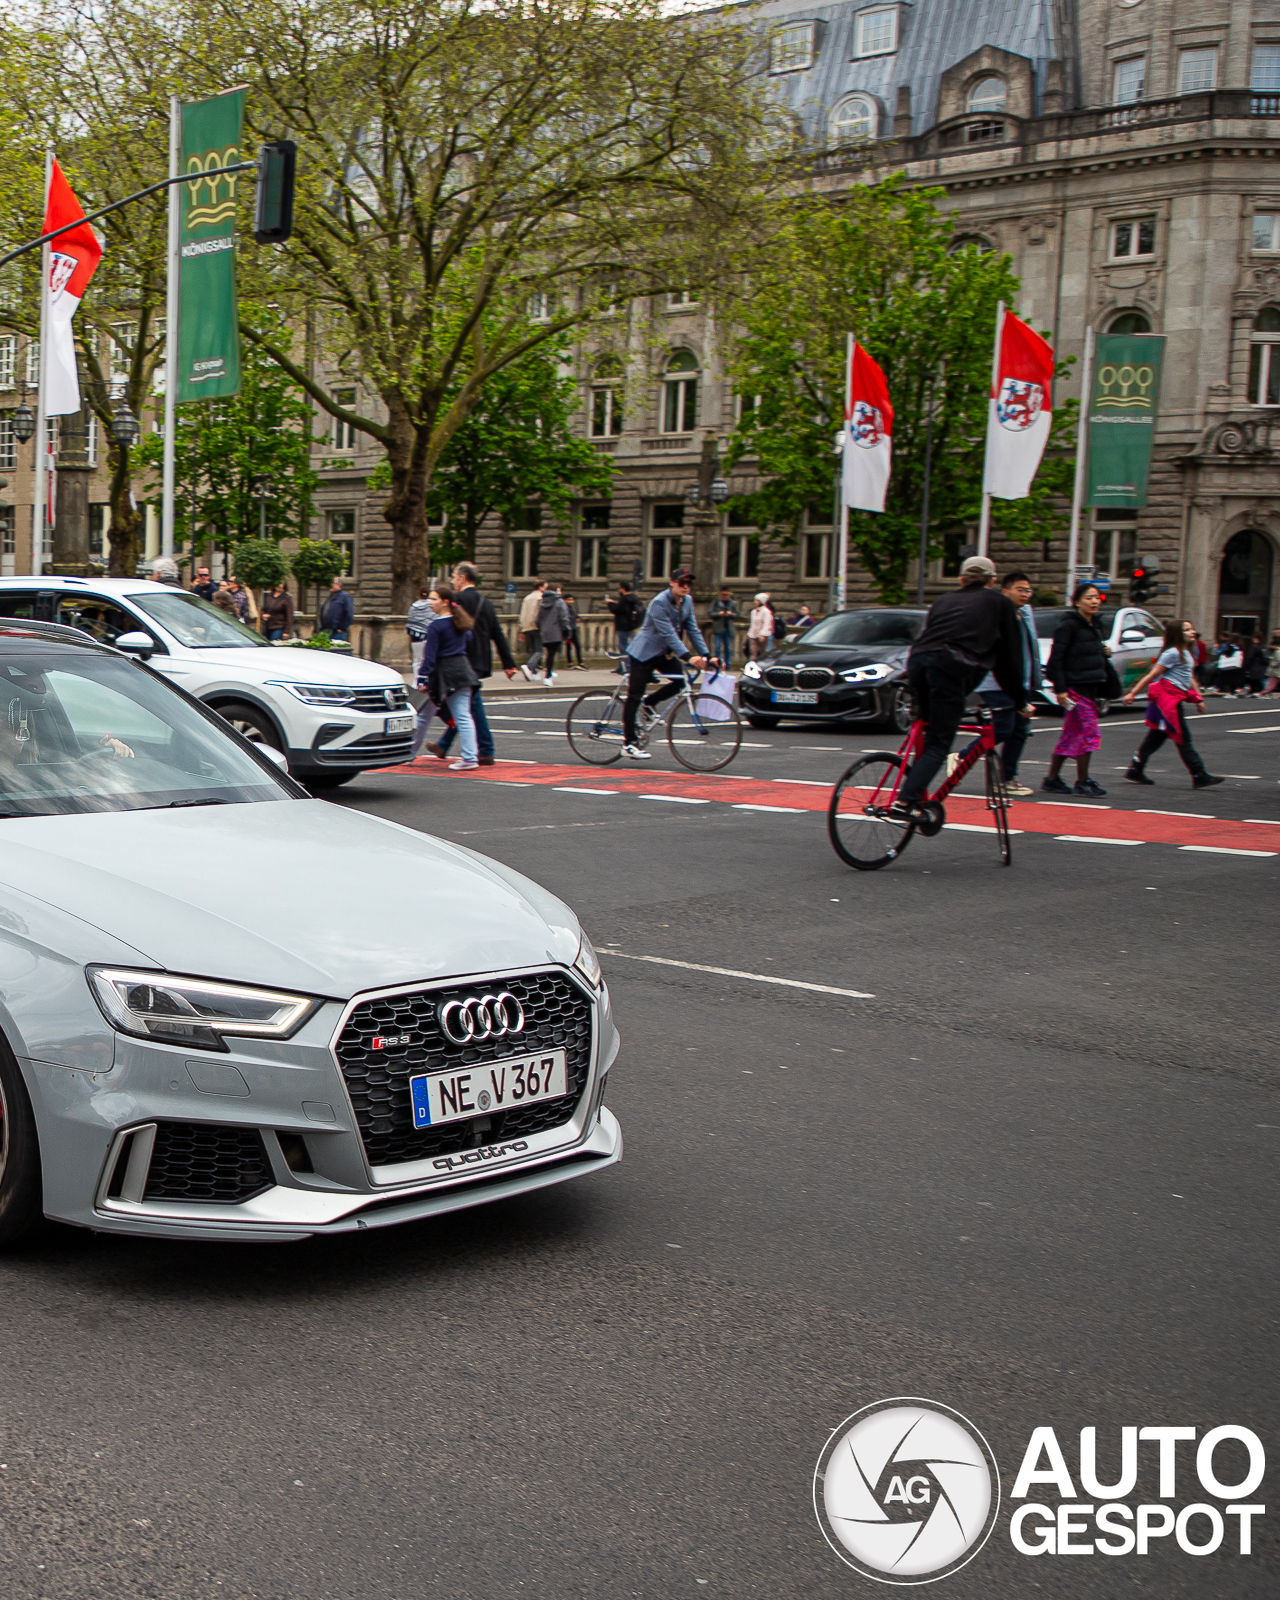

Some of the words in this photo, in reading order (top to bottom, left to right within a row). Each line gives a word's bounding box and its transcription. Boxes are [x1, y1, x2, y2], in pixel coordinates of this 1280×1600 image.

[378, 1037, 399, 1047] RS
[400, 1035, 410, 1044] 3
[439, 1074, 475, 1116] NE
[490, 1067, 506, 1104] V
[511, 1057, 555, 1100] 367
[418, 1107, 426, 1119] D
[432, 1140, 529, 1171] quattro
